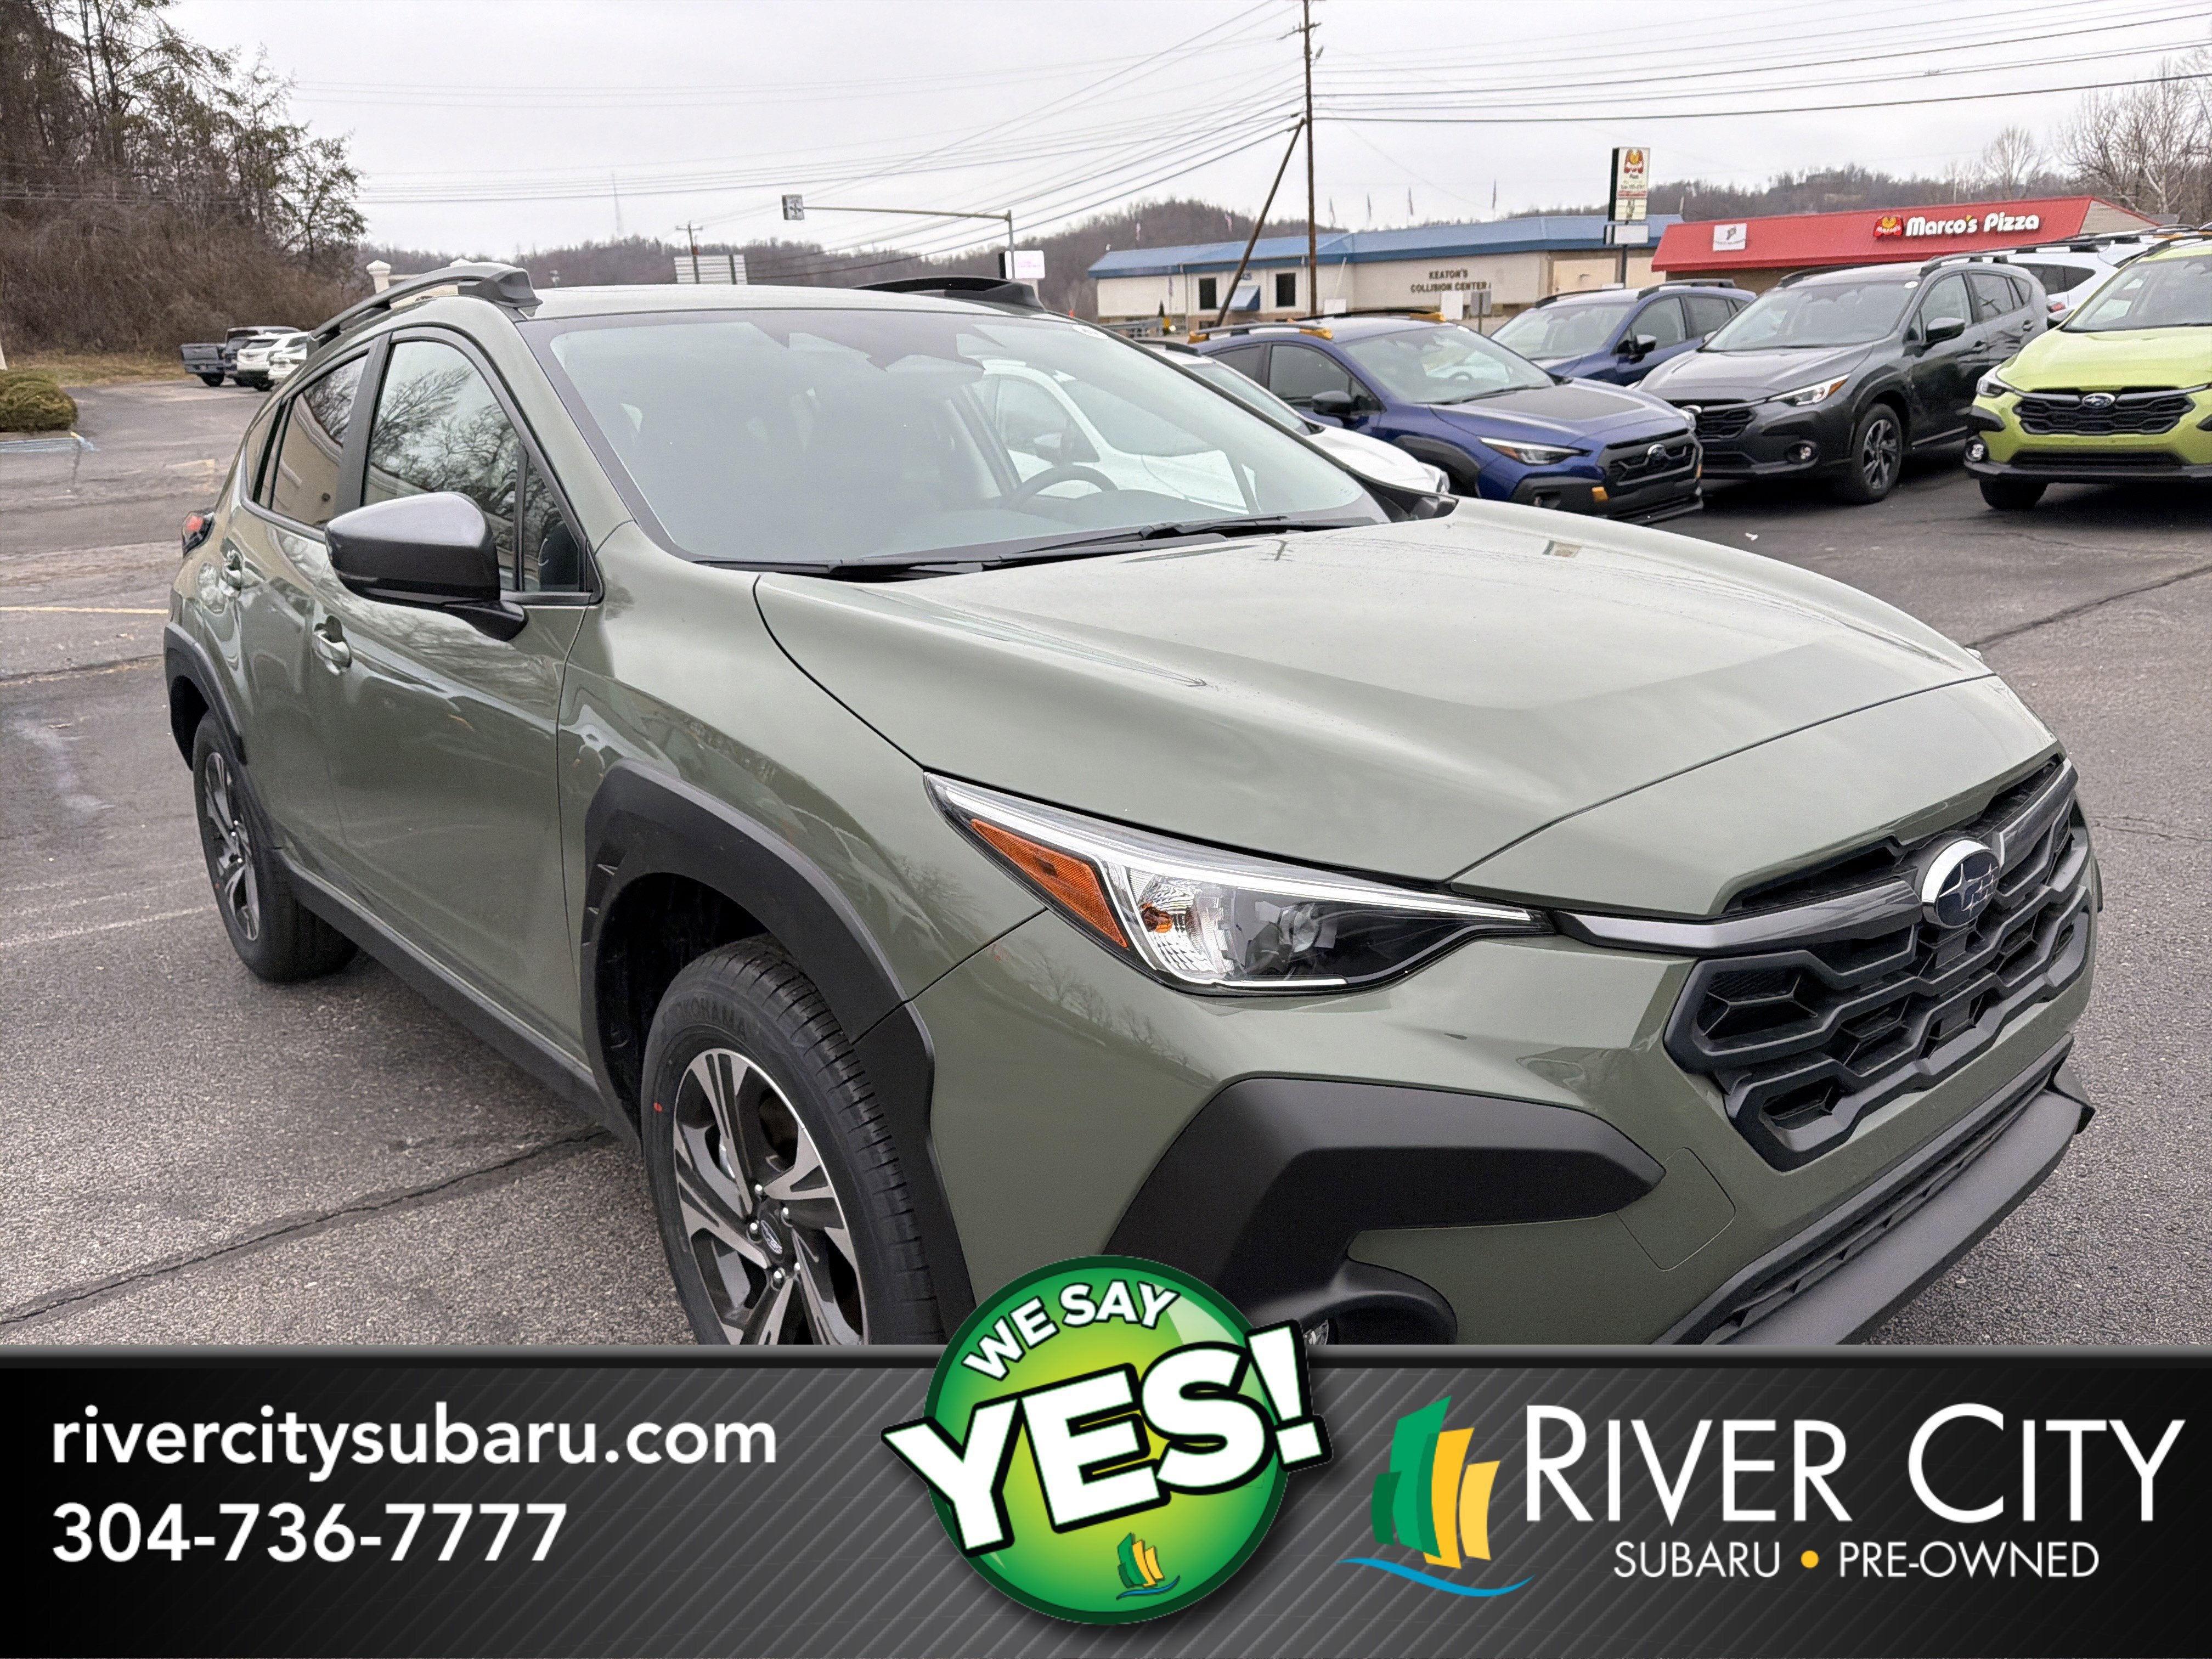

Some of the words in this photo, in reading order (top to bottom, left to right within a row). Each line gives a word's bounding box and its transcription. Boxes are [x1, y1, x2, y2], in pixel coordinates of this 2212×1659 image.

[1905, 215, 1978, 236] Marco's
[1983, 212, 2040, 232] Pizza
[1410, 283, 1453, 293] COLLISION
[1454, 281, 1487, 291] CENTER
